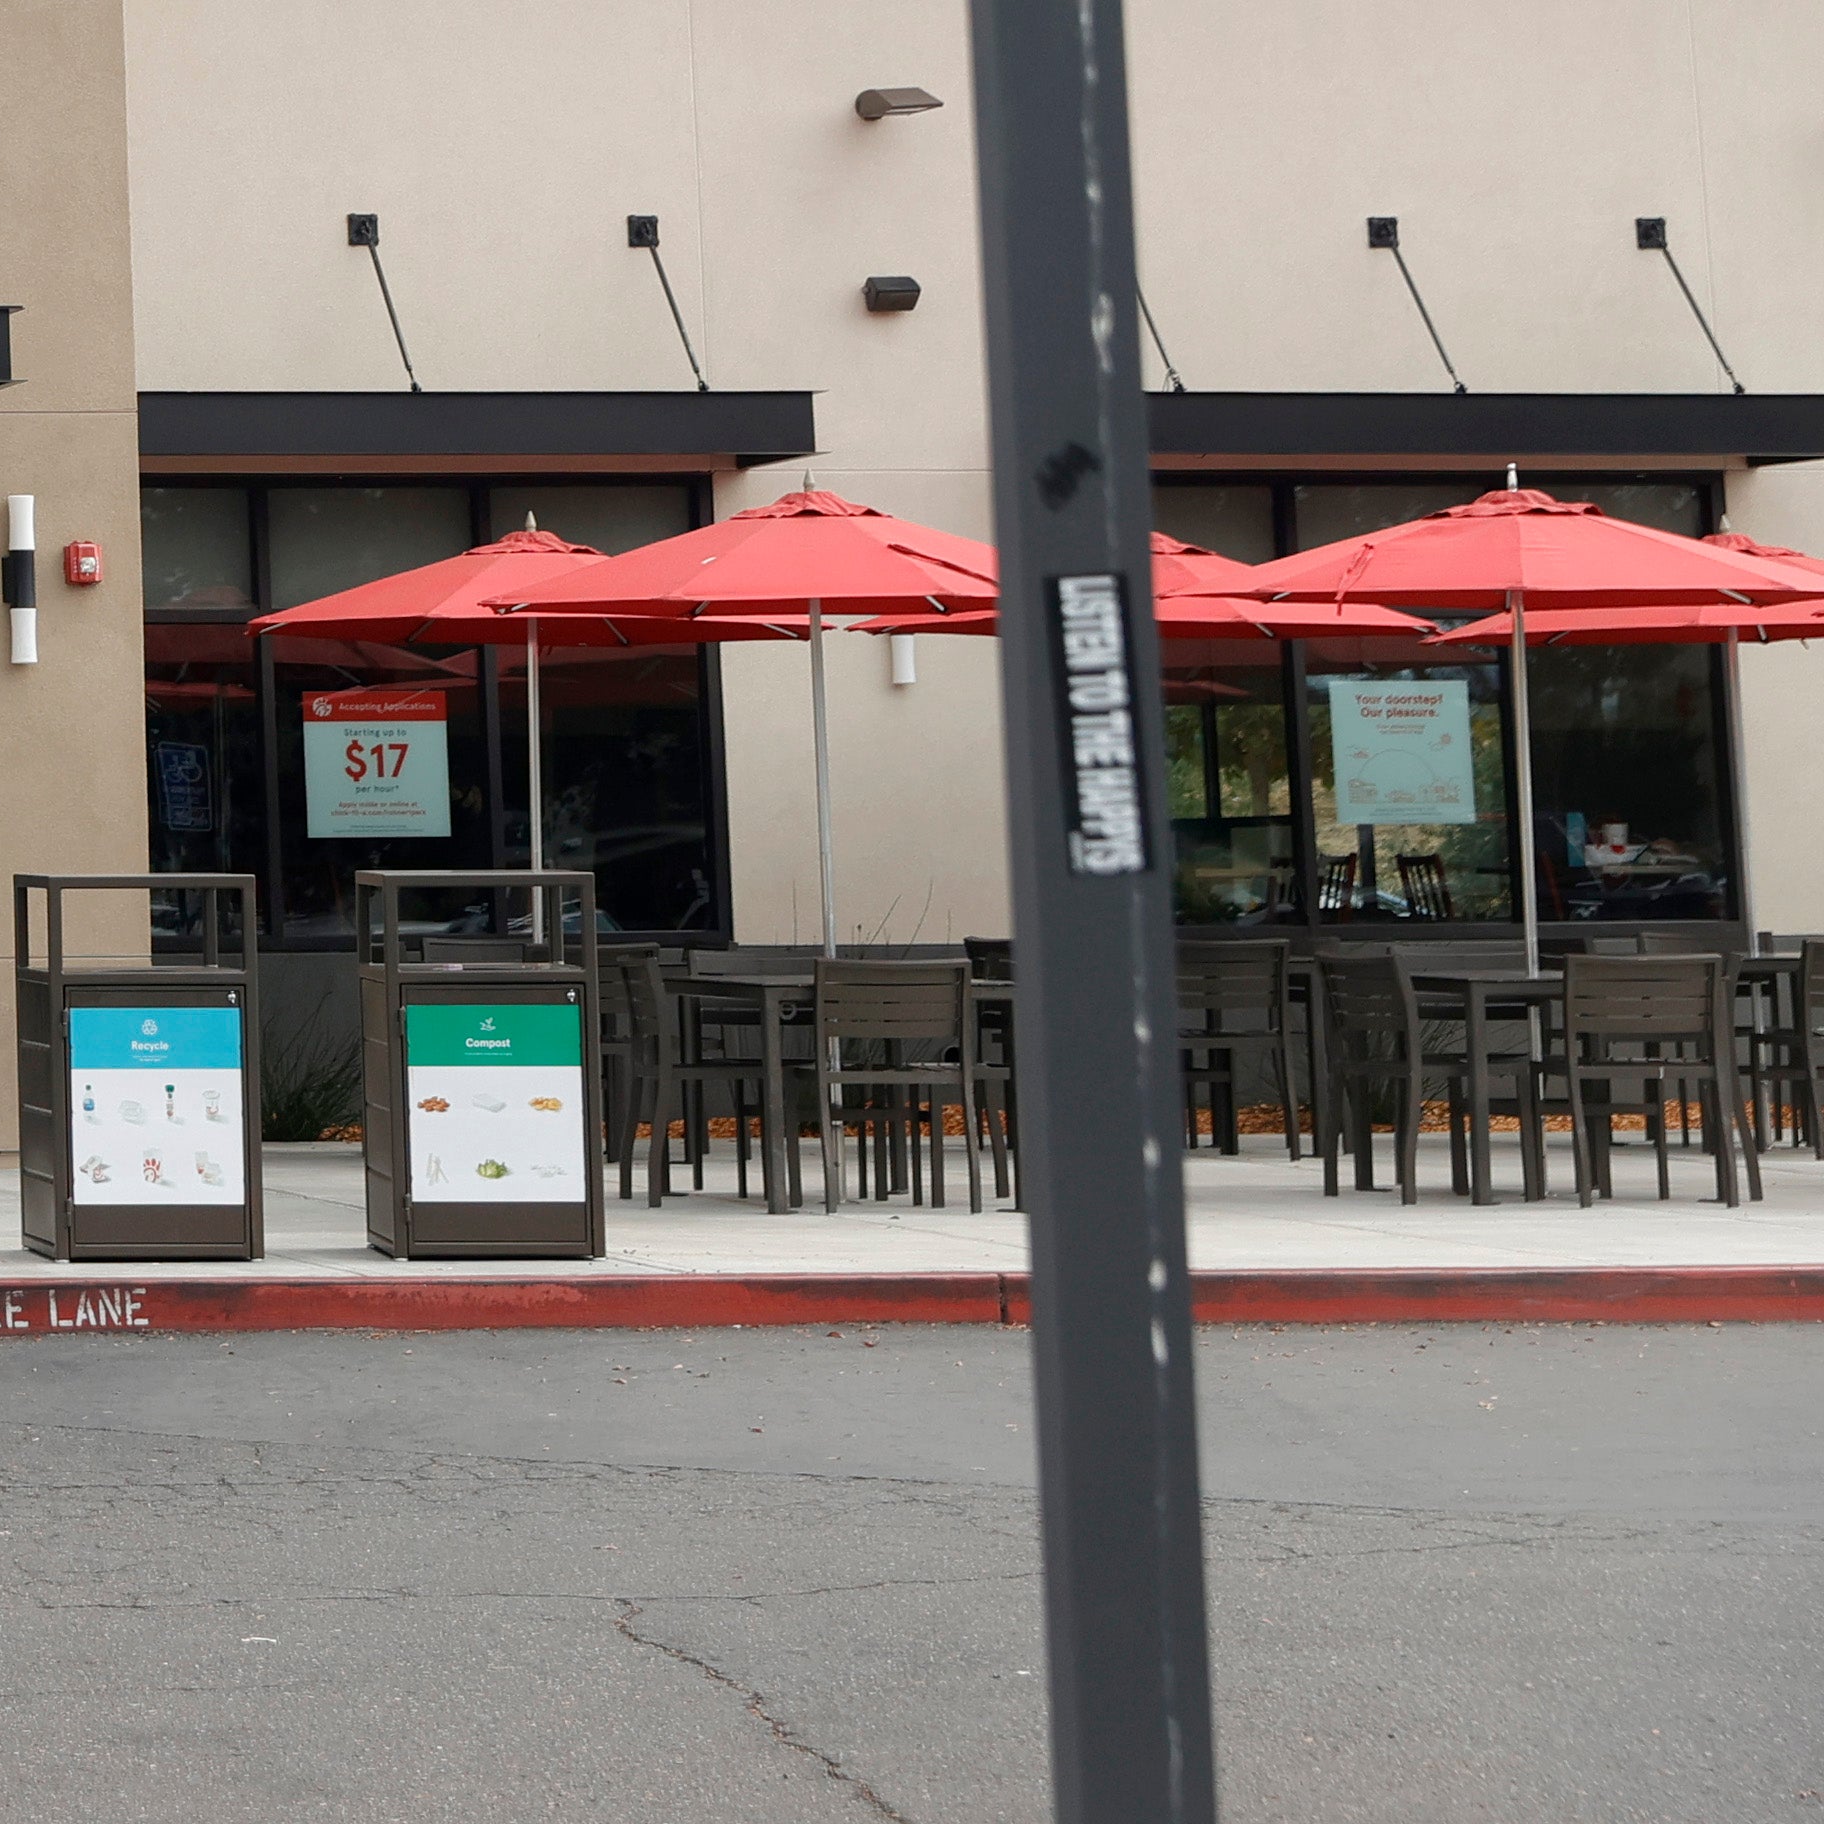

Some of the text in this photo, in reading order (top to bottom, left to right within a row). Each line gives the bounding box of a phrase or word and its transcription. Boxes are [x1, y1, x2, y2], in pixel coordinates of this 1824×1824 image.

[1058, 574, 1125, 672] LISTEN
[1067, 669, 1130, 711] TO
[1355, 693, 1443, 706] Your doorstep?
[338, 702, 437, 714] Accepting Applications
[1360, 707, 1439, 719] Our pleasure.
[343, 728, 407, 738] Starting up to
[1071, 709, 1135, 768] THE
[344, 739, 410, 782] $17
[355, 786, 371, 794] per
[131, 1040, 170, 1053] Recycle
[465, 1037, 511, 1049] Compost
[48, 1287, 150, 1327] LANE
